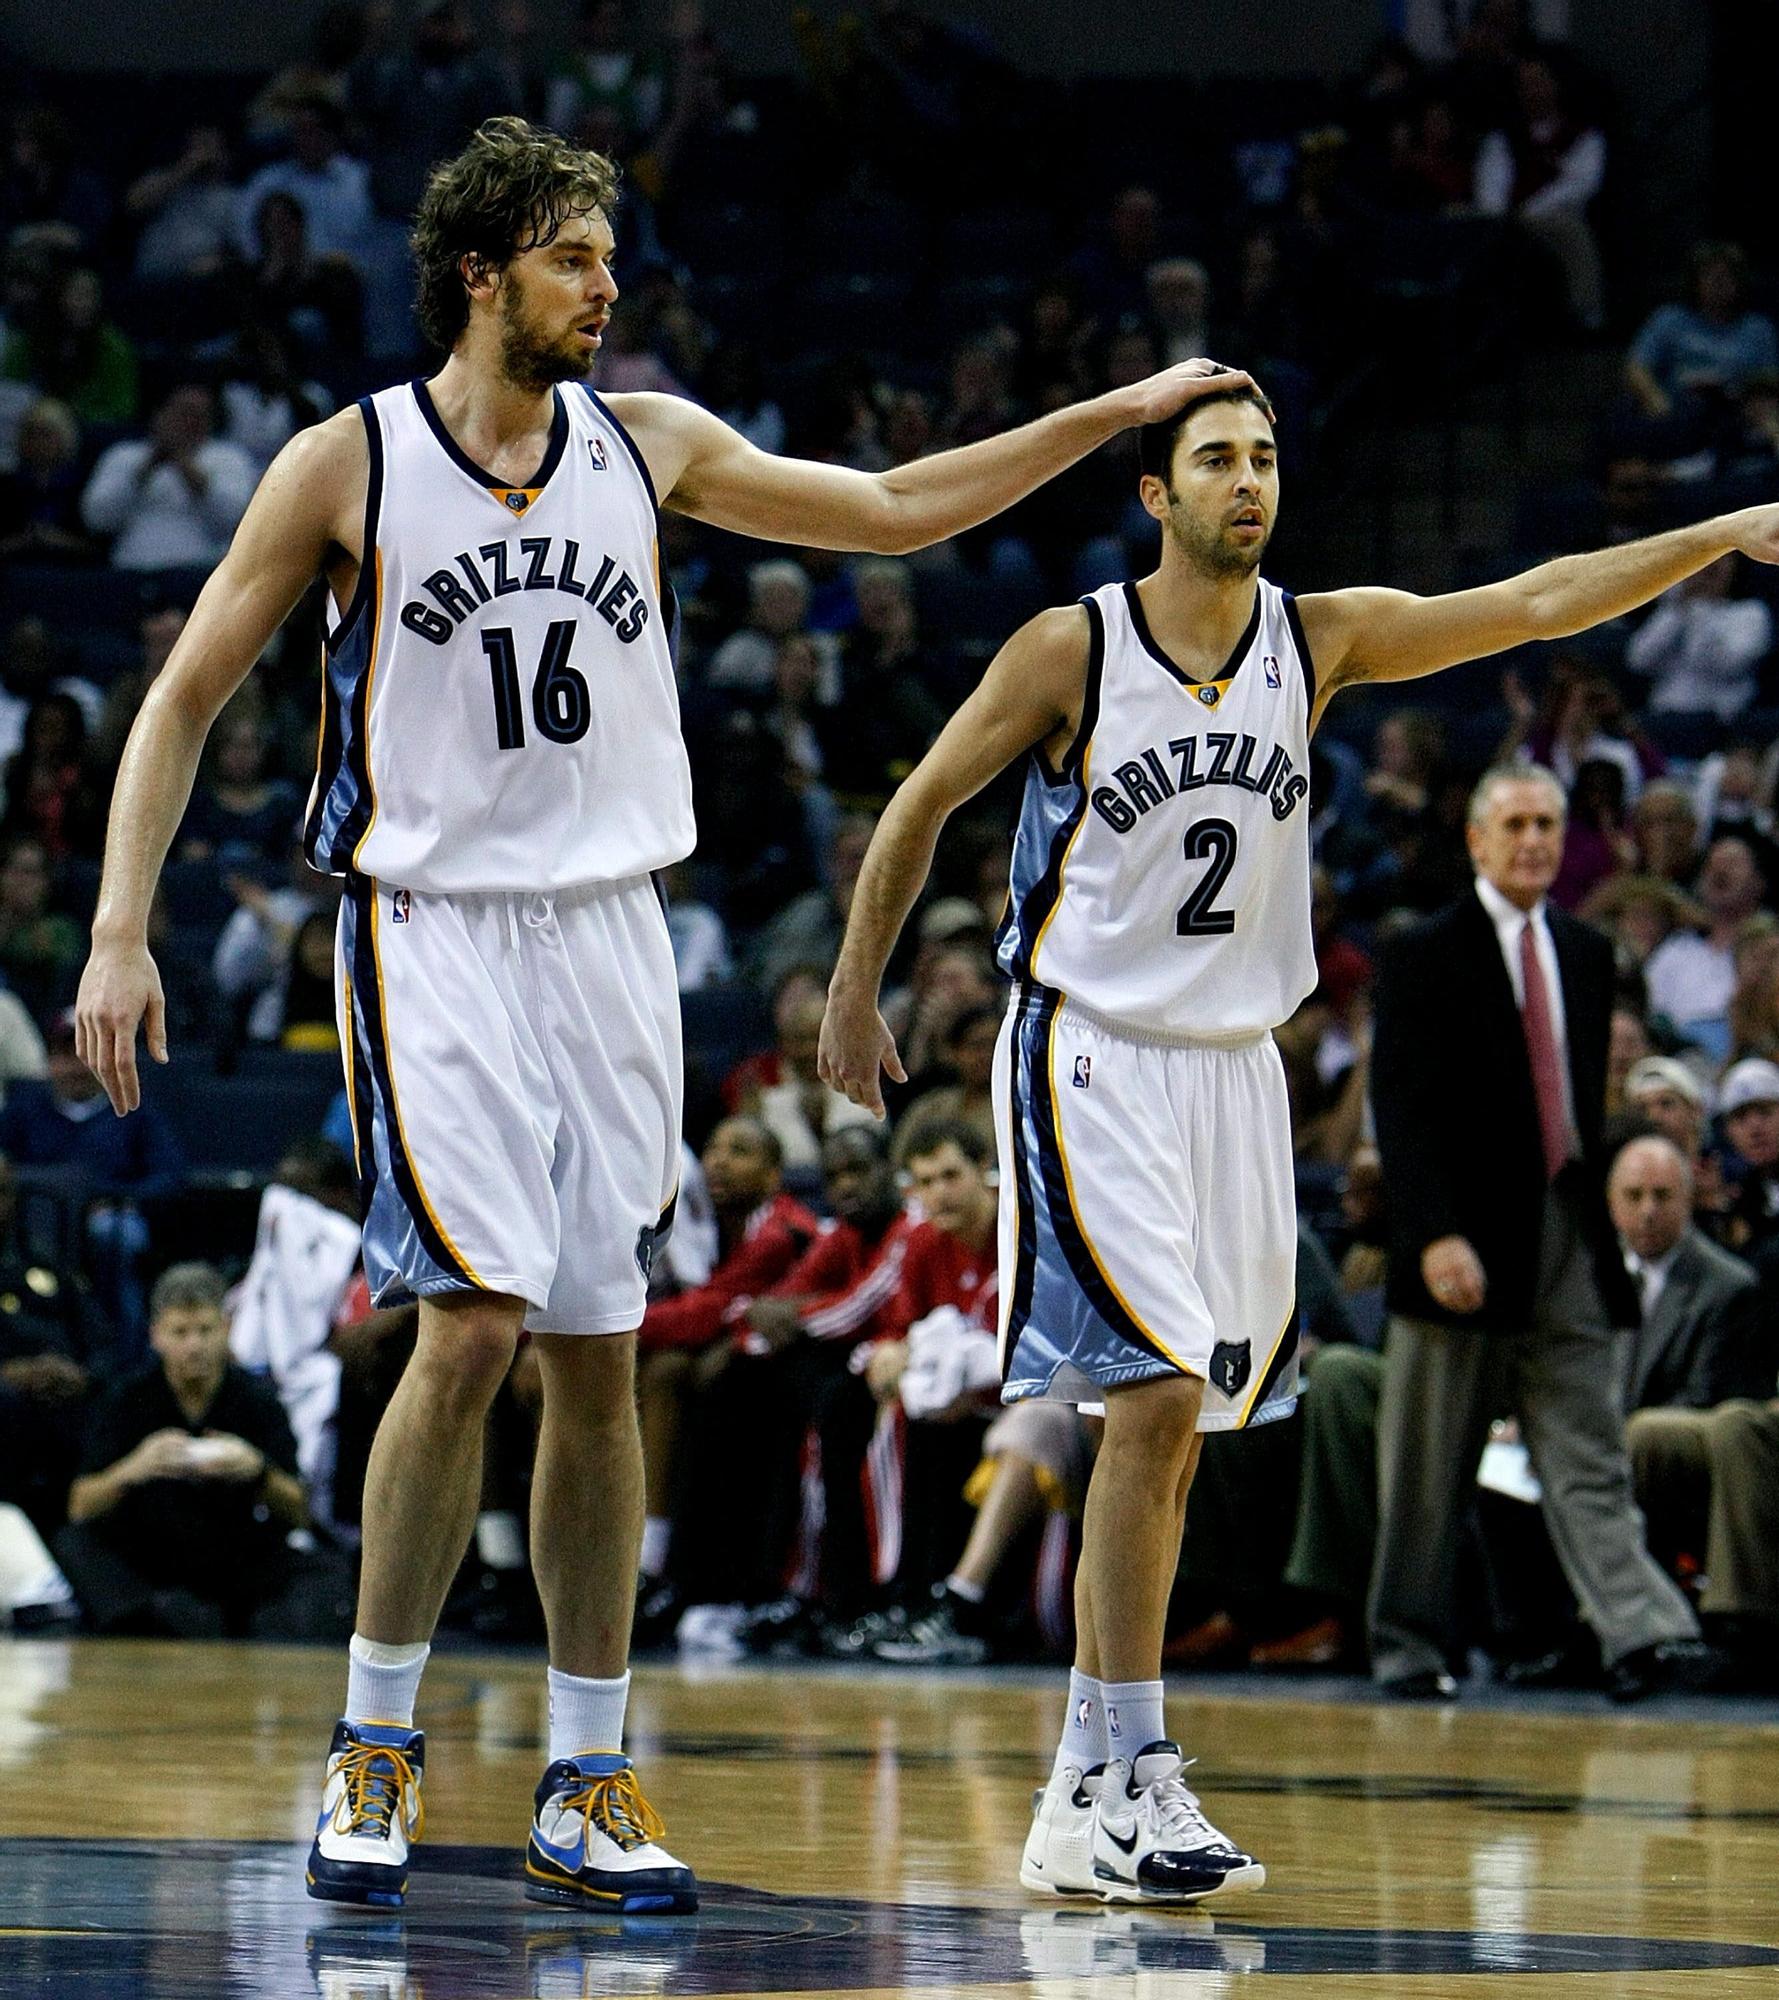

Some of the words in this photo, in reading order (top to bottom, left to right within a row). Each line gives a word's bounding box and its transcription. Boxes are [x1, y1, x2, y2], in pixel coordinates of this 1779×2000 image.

[401, 537, 649, 645] GRIZZLIES
[481, 620, 591, 750] 16
[1091, 732, 1308, 834] GRIZZLIES
[1176, 817, 1237, 936] 2
